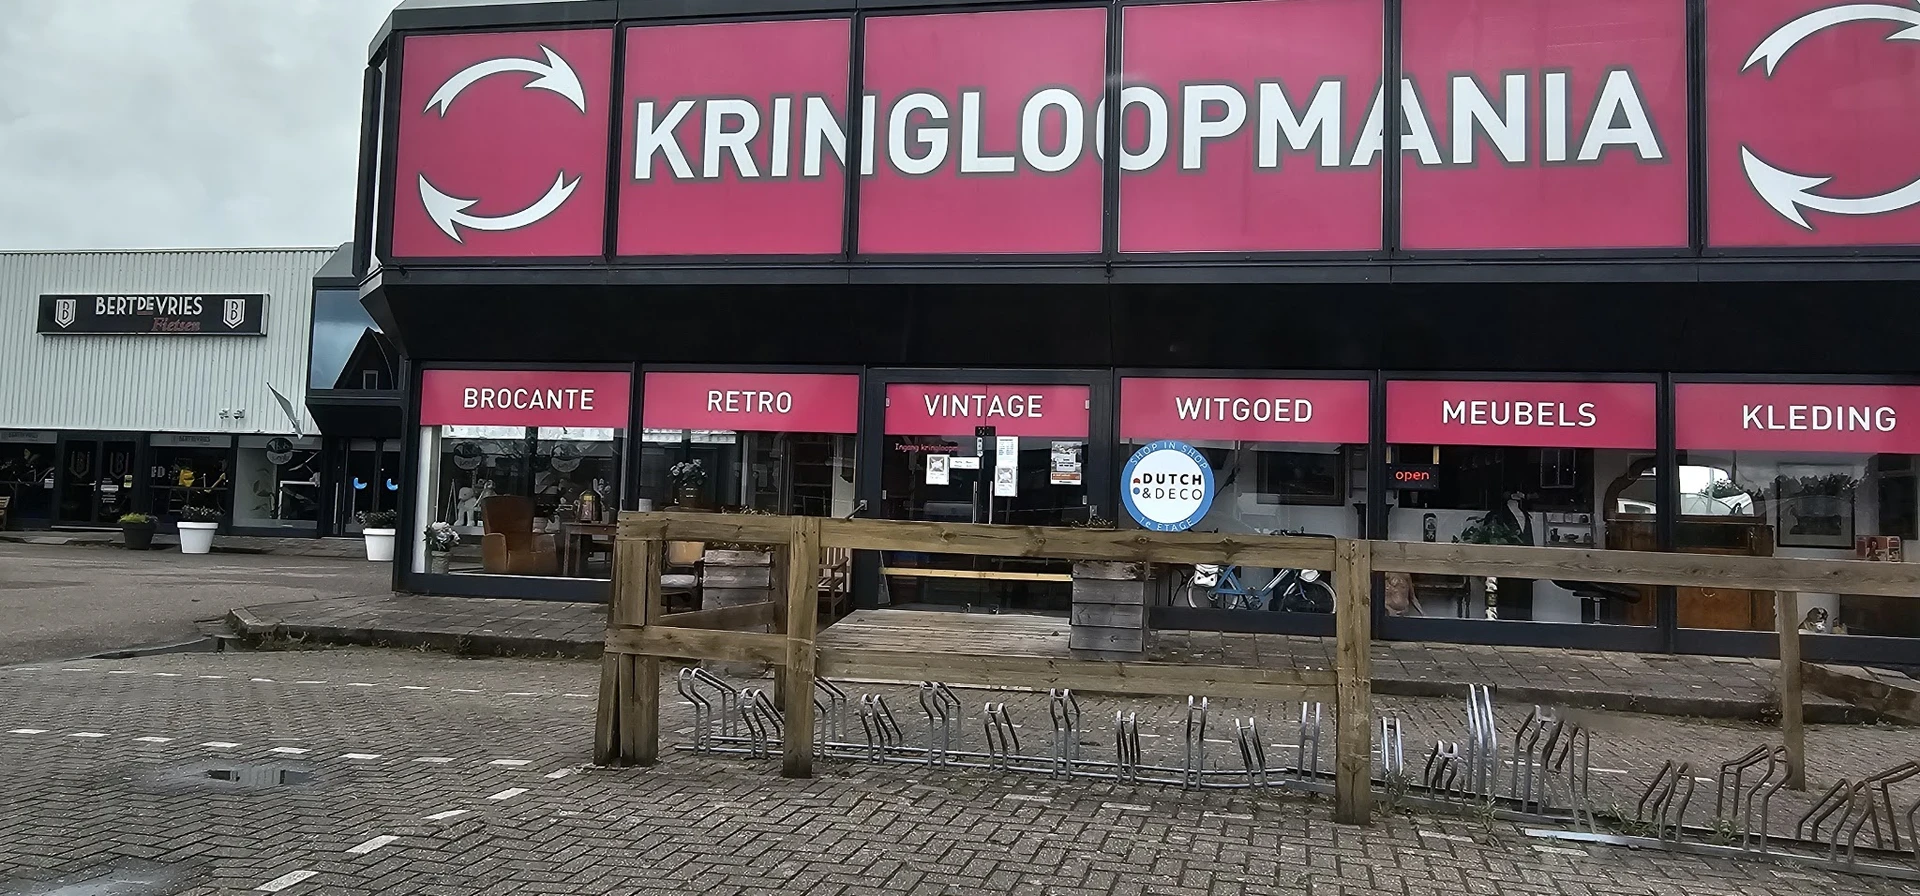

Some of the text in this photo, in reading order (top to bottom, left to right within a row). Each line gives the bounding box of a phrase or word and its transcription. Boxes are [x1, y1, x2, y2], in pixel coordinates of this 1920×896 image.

[635, 70, 1663, 179] KRINGLOOPMANIA
[464, 388, 594, 410] BROCANTE
[707, 391, 792, 413] RETRO
[924, 394, 1043, 418] VINTAGE
[1175, 397, 1313, 423] WITGOED
[1442, 400, 1597, 427] MEUBELS
[1743, 404, 1896, 432] KLEDING
[895, 443, 920, 453] Ingang
[1130, 441, 1208, 469] SHOP IN SHOP
[1143, 473, 1202, 485] DUTCH
[1395, 471, 1430, 482] open
[1156, 518, 1194, 532] ETAGE
